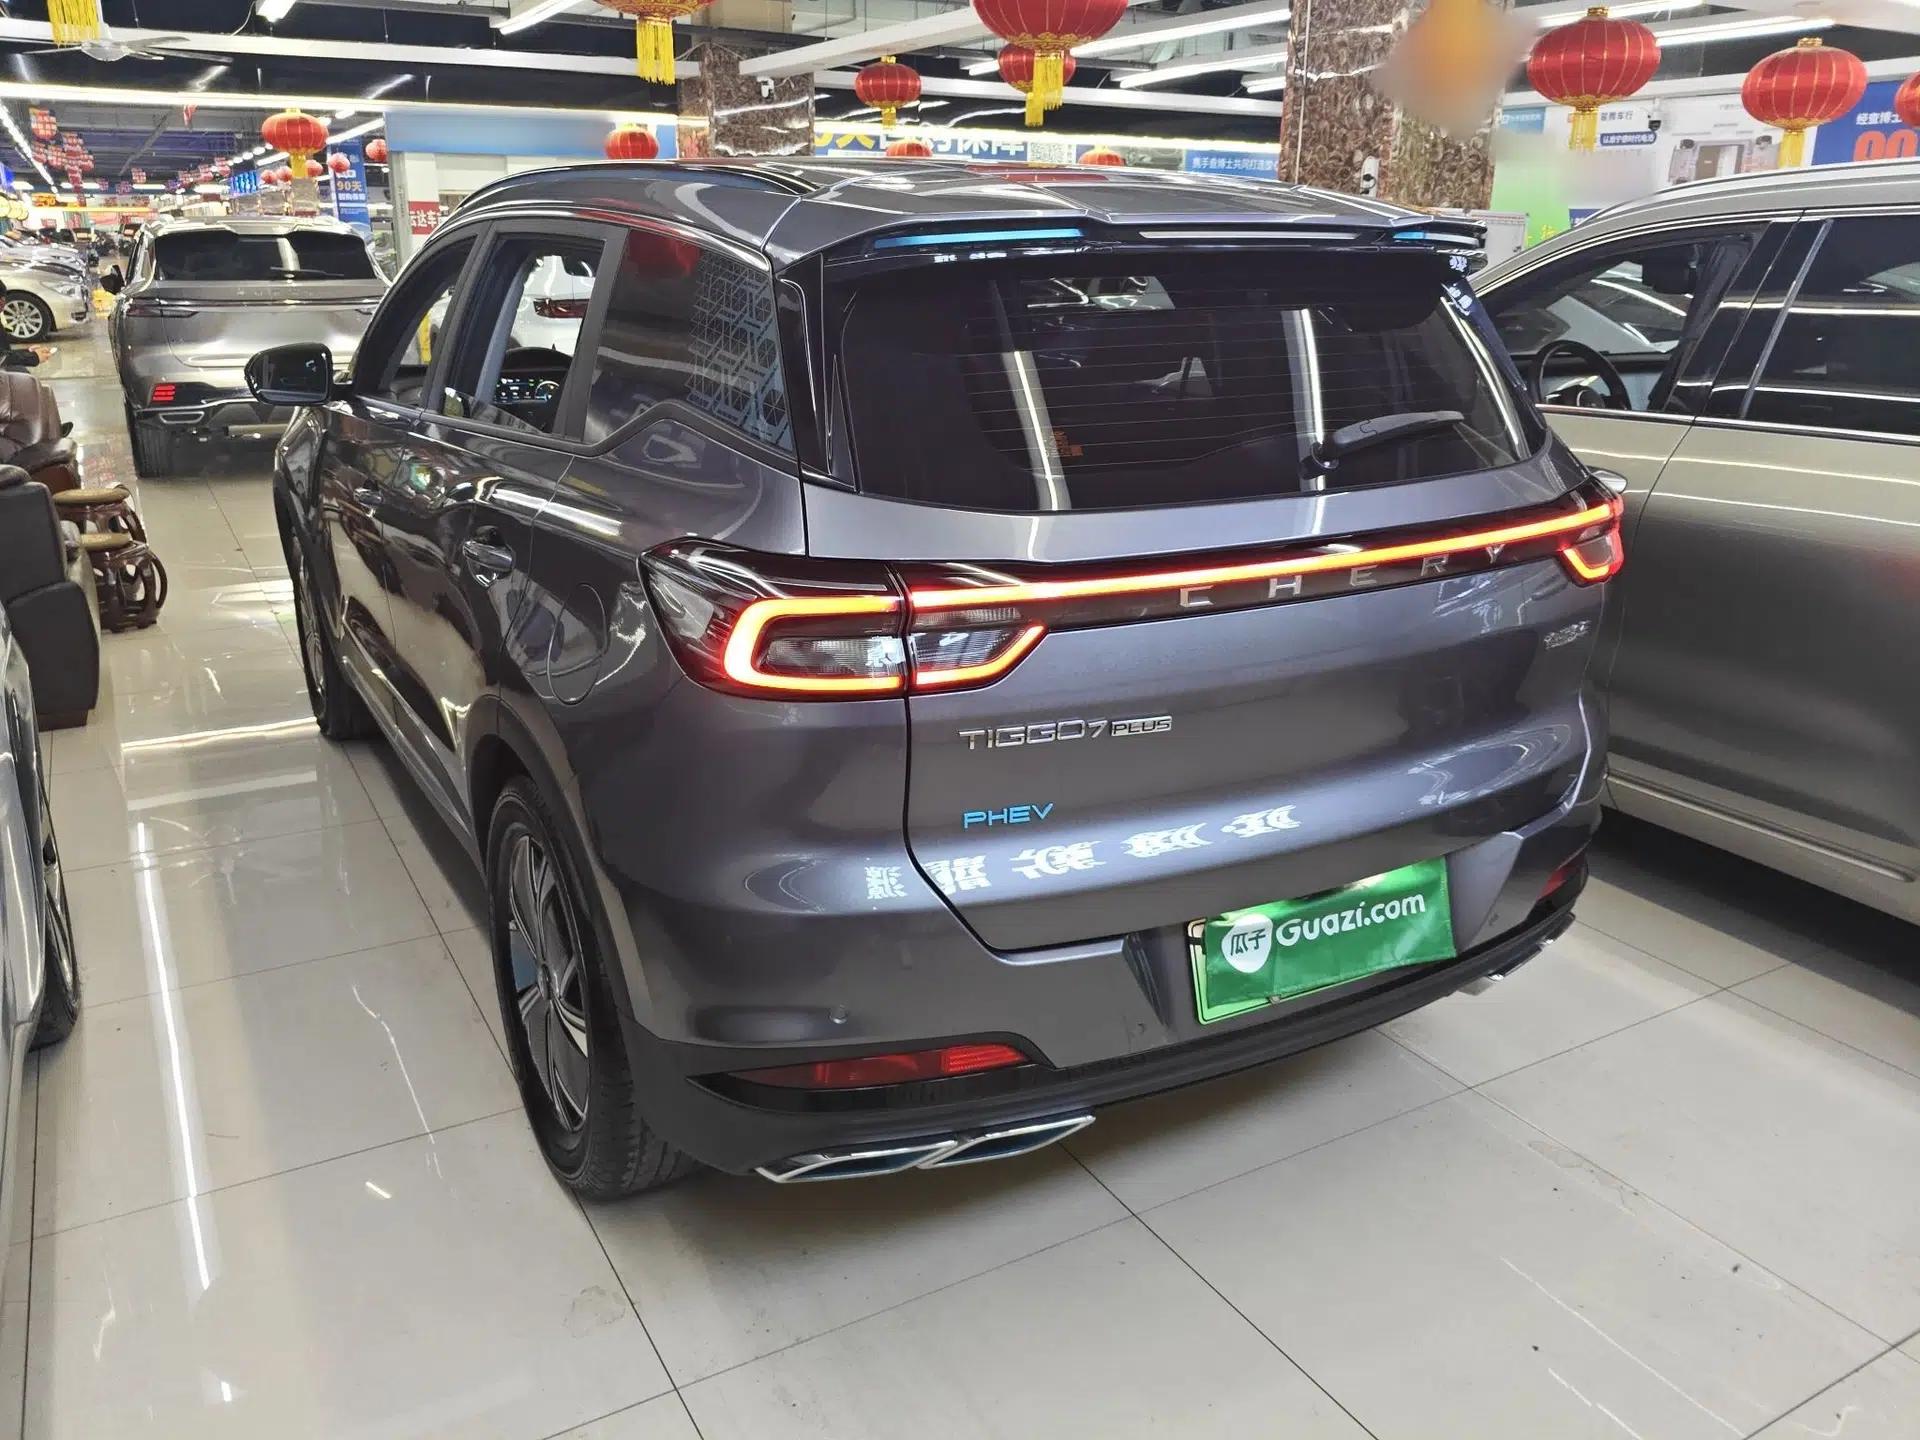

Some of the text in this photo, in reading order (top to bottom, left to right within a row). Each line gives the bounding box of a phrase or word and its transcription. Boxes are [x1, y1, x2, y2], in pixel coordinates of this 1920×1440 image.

[1180, 544, 1504, 607] CHERY
[963, 802, 1053, 829] PHEV
[1230, 892, 1426, 957] 瓜子 Guazi.com
